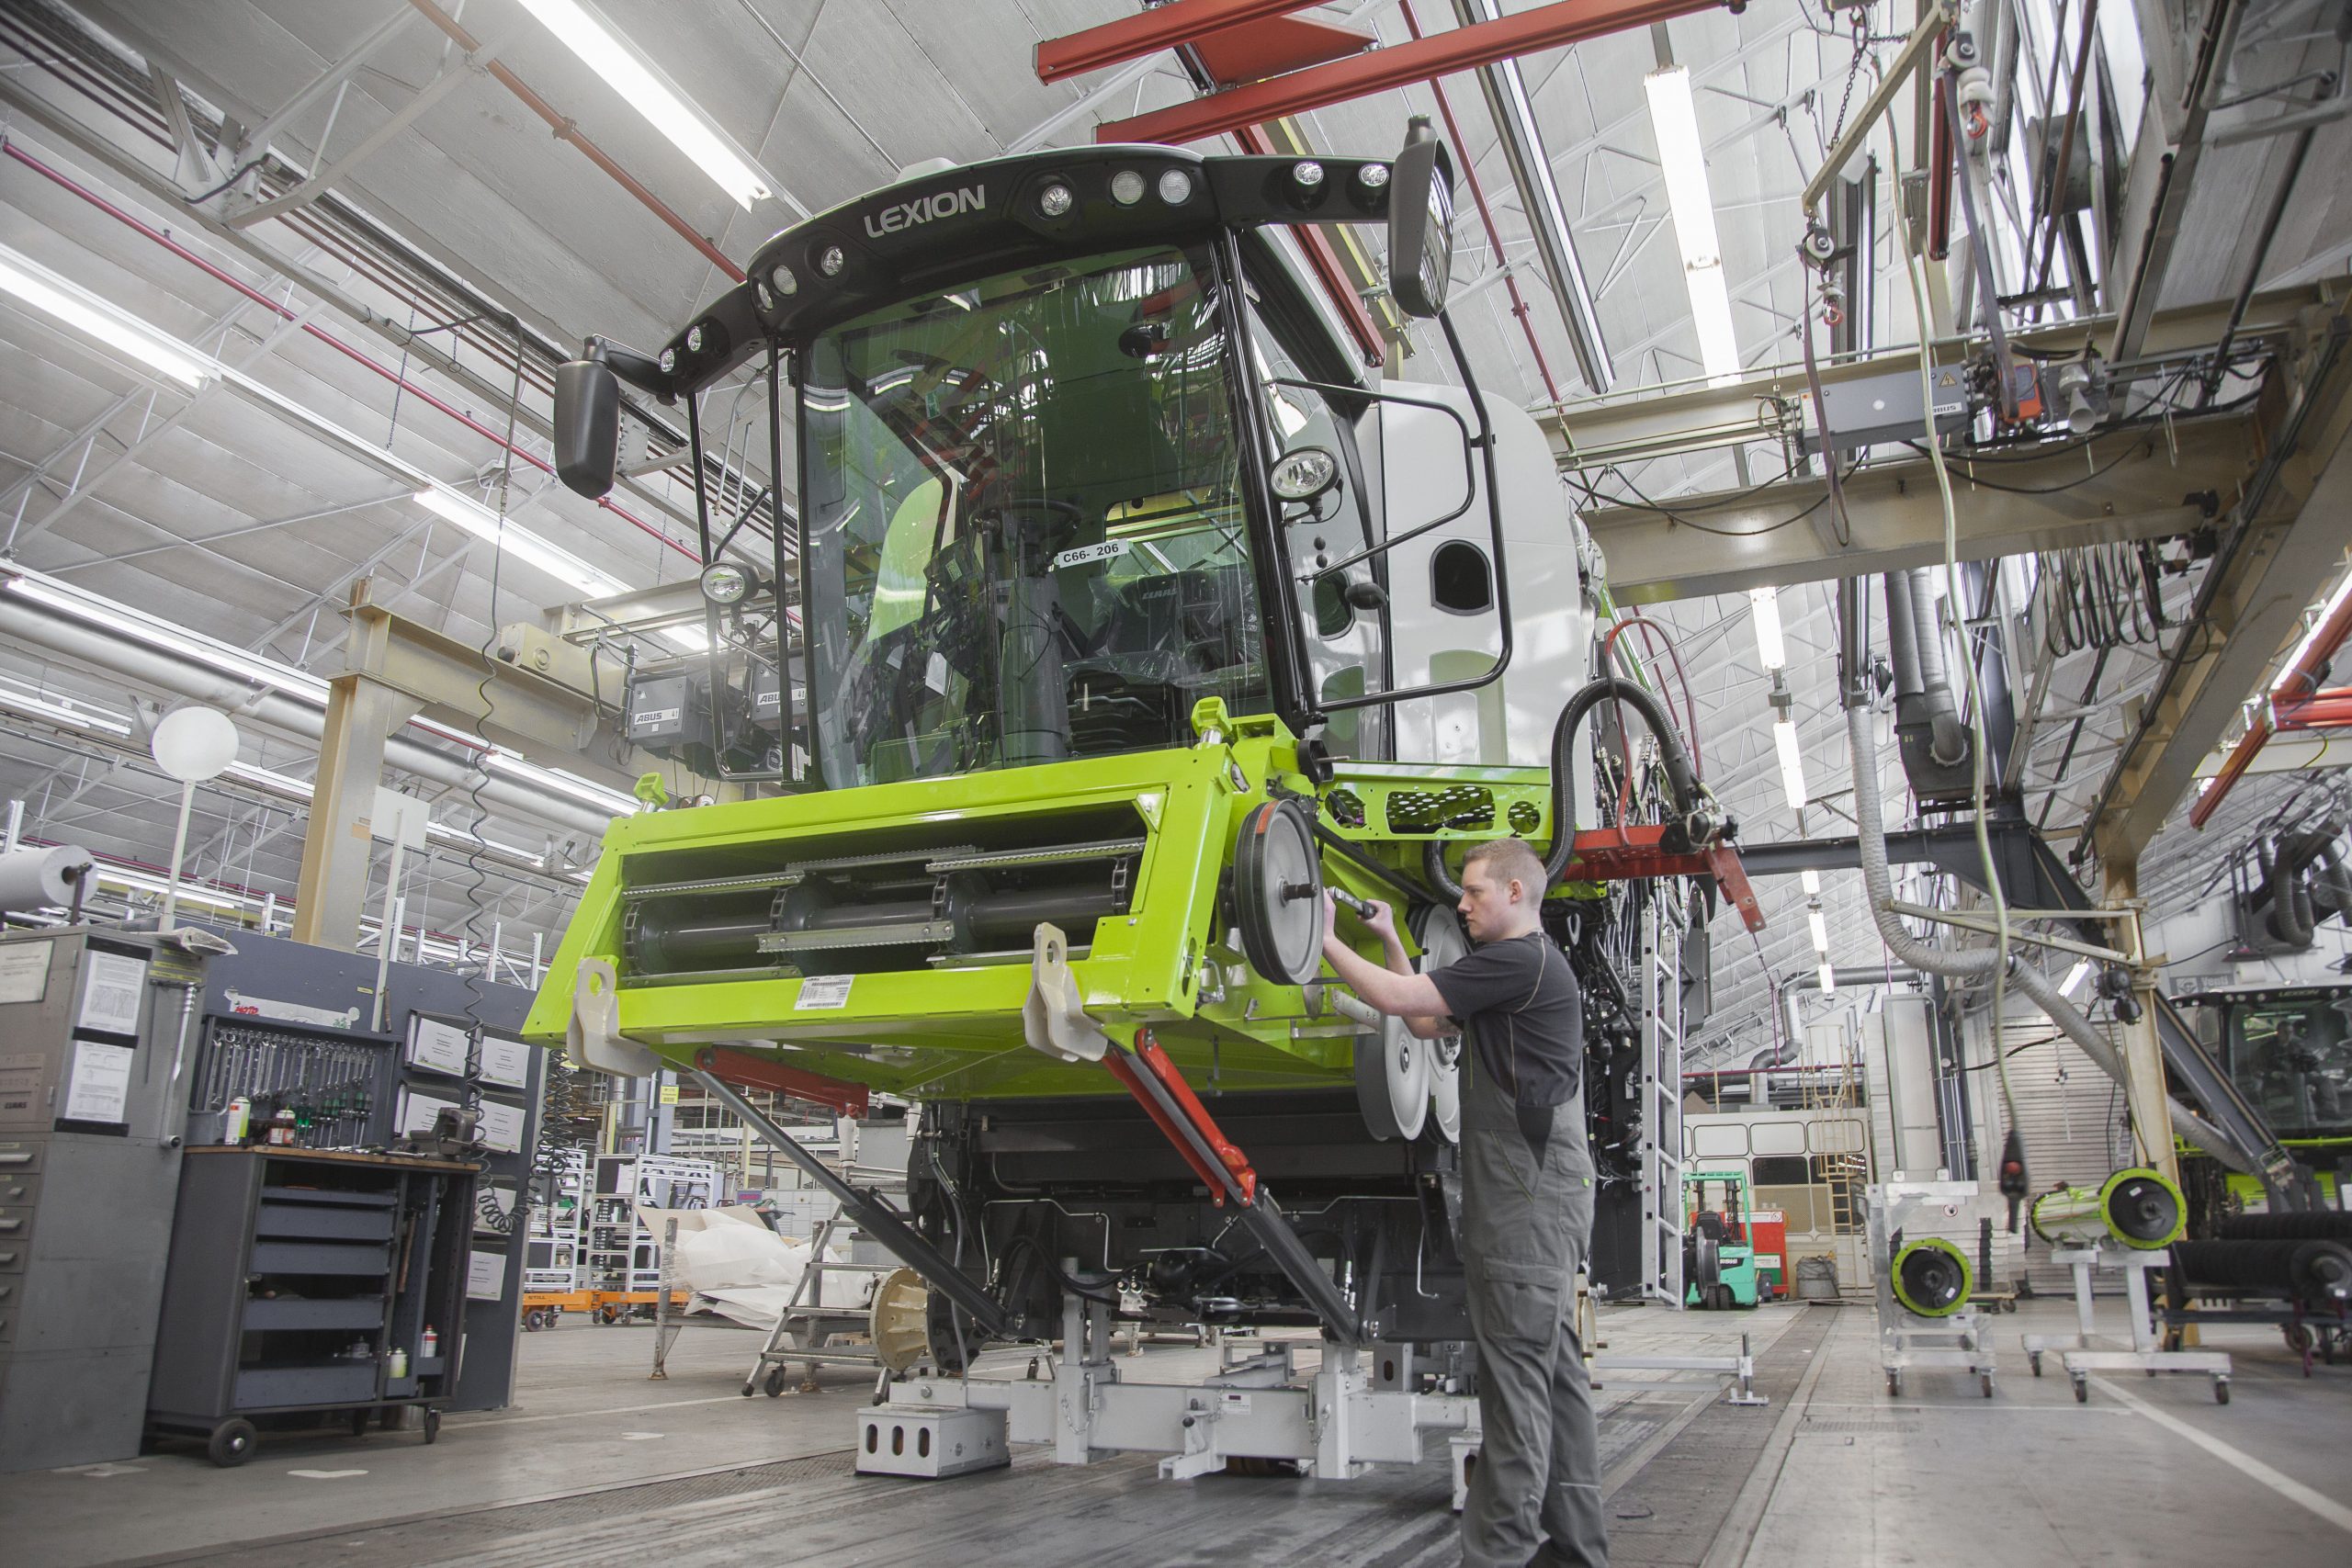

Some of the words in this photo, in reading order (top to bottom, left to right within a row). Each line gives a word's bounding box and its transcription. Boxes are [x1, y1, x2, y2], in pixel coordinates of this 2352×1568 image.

[864, 184, 986, 239] LEXION
[1063, 549, 1091, 563] C66-
[1096, 543, 1119, 557] 206
[759, 693, 780, 704] ABU
[636, 712, 662, 723] ABUS
